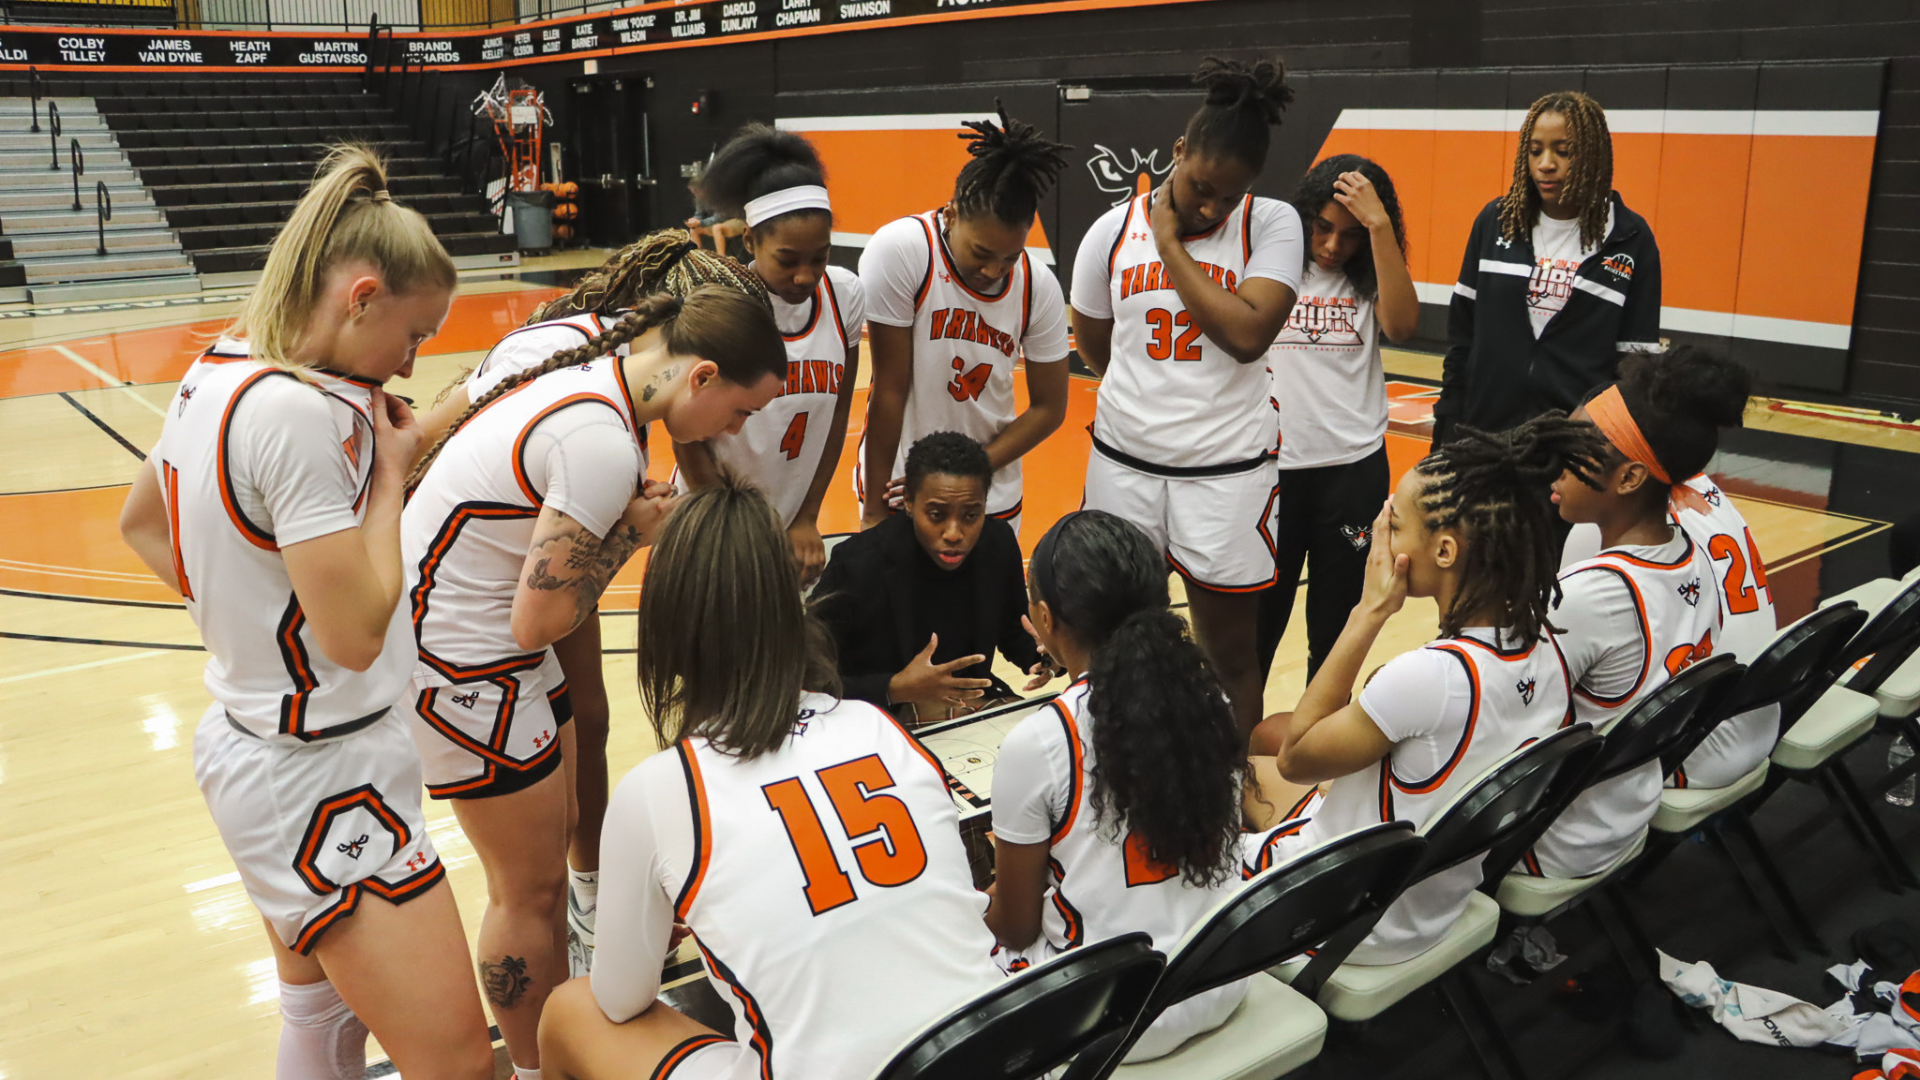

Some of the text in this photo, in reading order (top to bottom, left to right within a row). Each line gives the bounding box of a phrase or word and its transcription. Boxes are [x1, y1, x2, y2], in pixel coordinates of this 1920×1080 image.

[723, 1, 756, 17] DAROLD
[840, 0, 890, 19] SWANSON
[721, 16, 758, 32] DUNLAVY
[776, 8, 820, 26] CHAPMAN
[575, 23, 593, 36] KATIE
[620, 30, 647, 43] WILSON
[671, 22, 706, 37] WILLIAMS
[58, 37, 105, 49] COLBY
[147, 39, 192, 51] JAMES
[229, 41, 271, 52] HEATH
[314, 41, 359, 52] MARTIN
[408, 41, 452, 52] BRANDI
[60, 50, 106, 62] TILLEY
[138, 51, 203, 63] VAN DYNE
[235, 52, 268, 64] ZAPF
[299, 53, 368, 64] GUSTAVSSO
[1570, 261, 1582, 269] TH
[1604, 265, 1632, 280] BASKETBAL
[1283, 303, 1358, 332] OURT
[1145, 307, 1203, 361] 32
[947, 355, 993, 402] 34
[780, 411, 809, 461] 4
[1708, 526, 1773, 615] 24
[761, 753, 928, 916] 15
